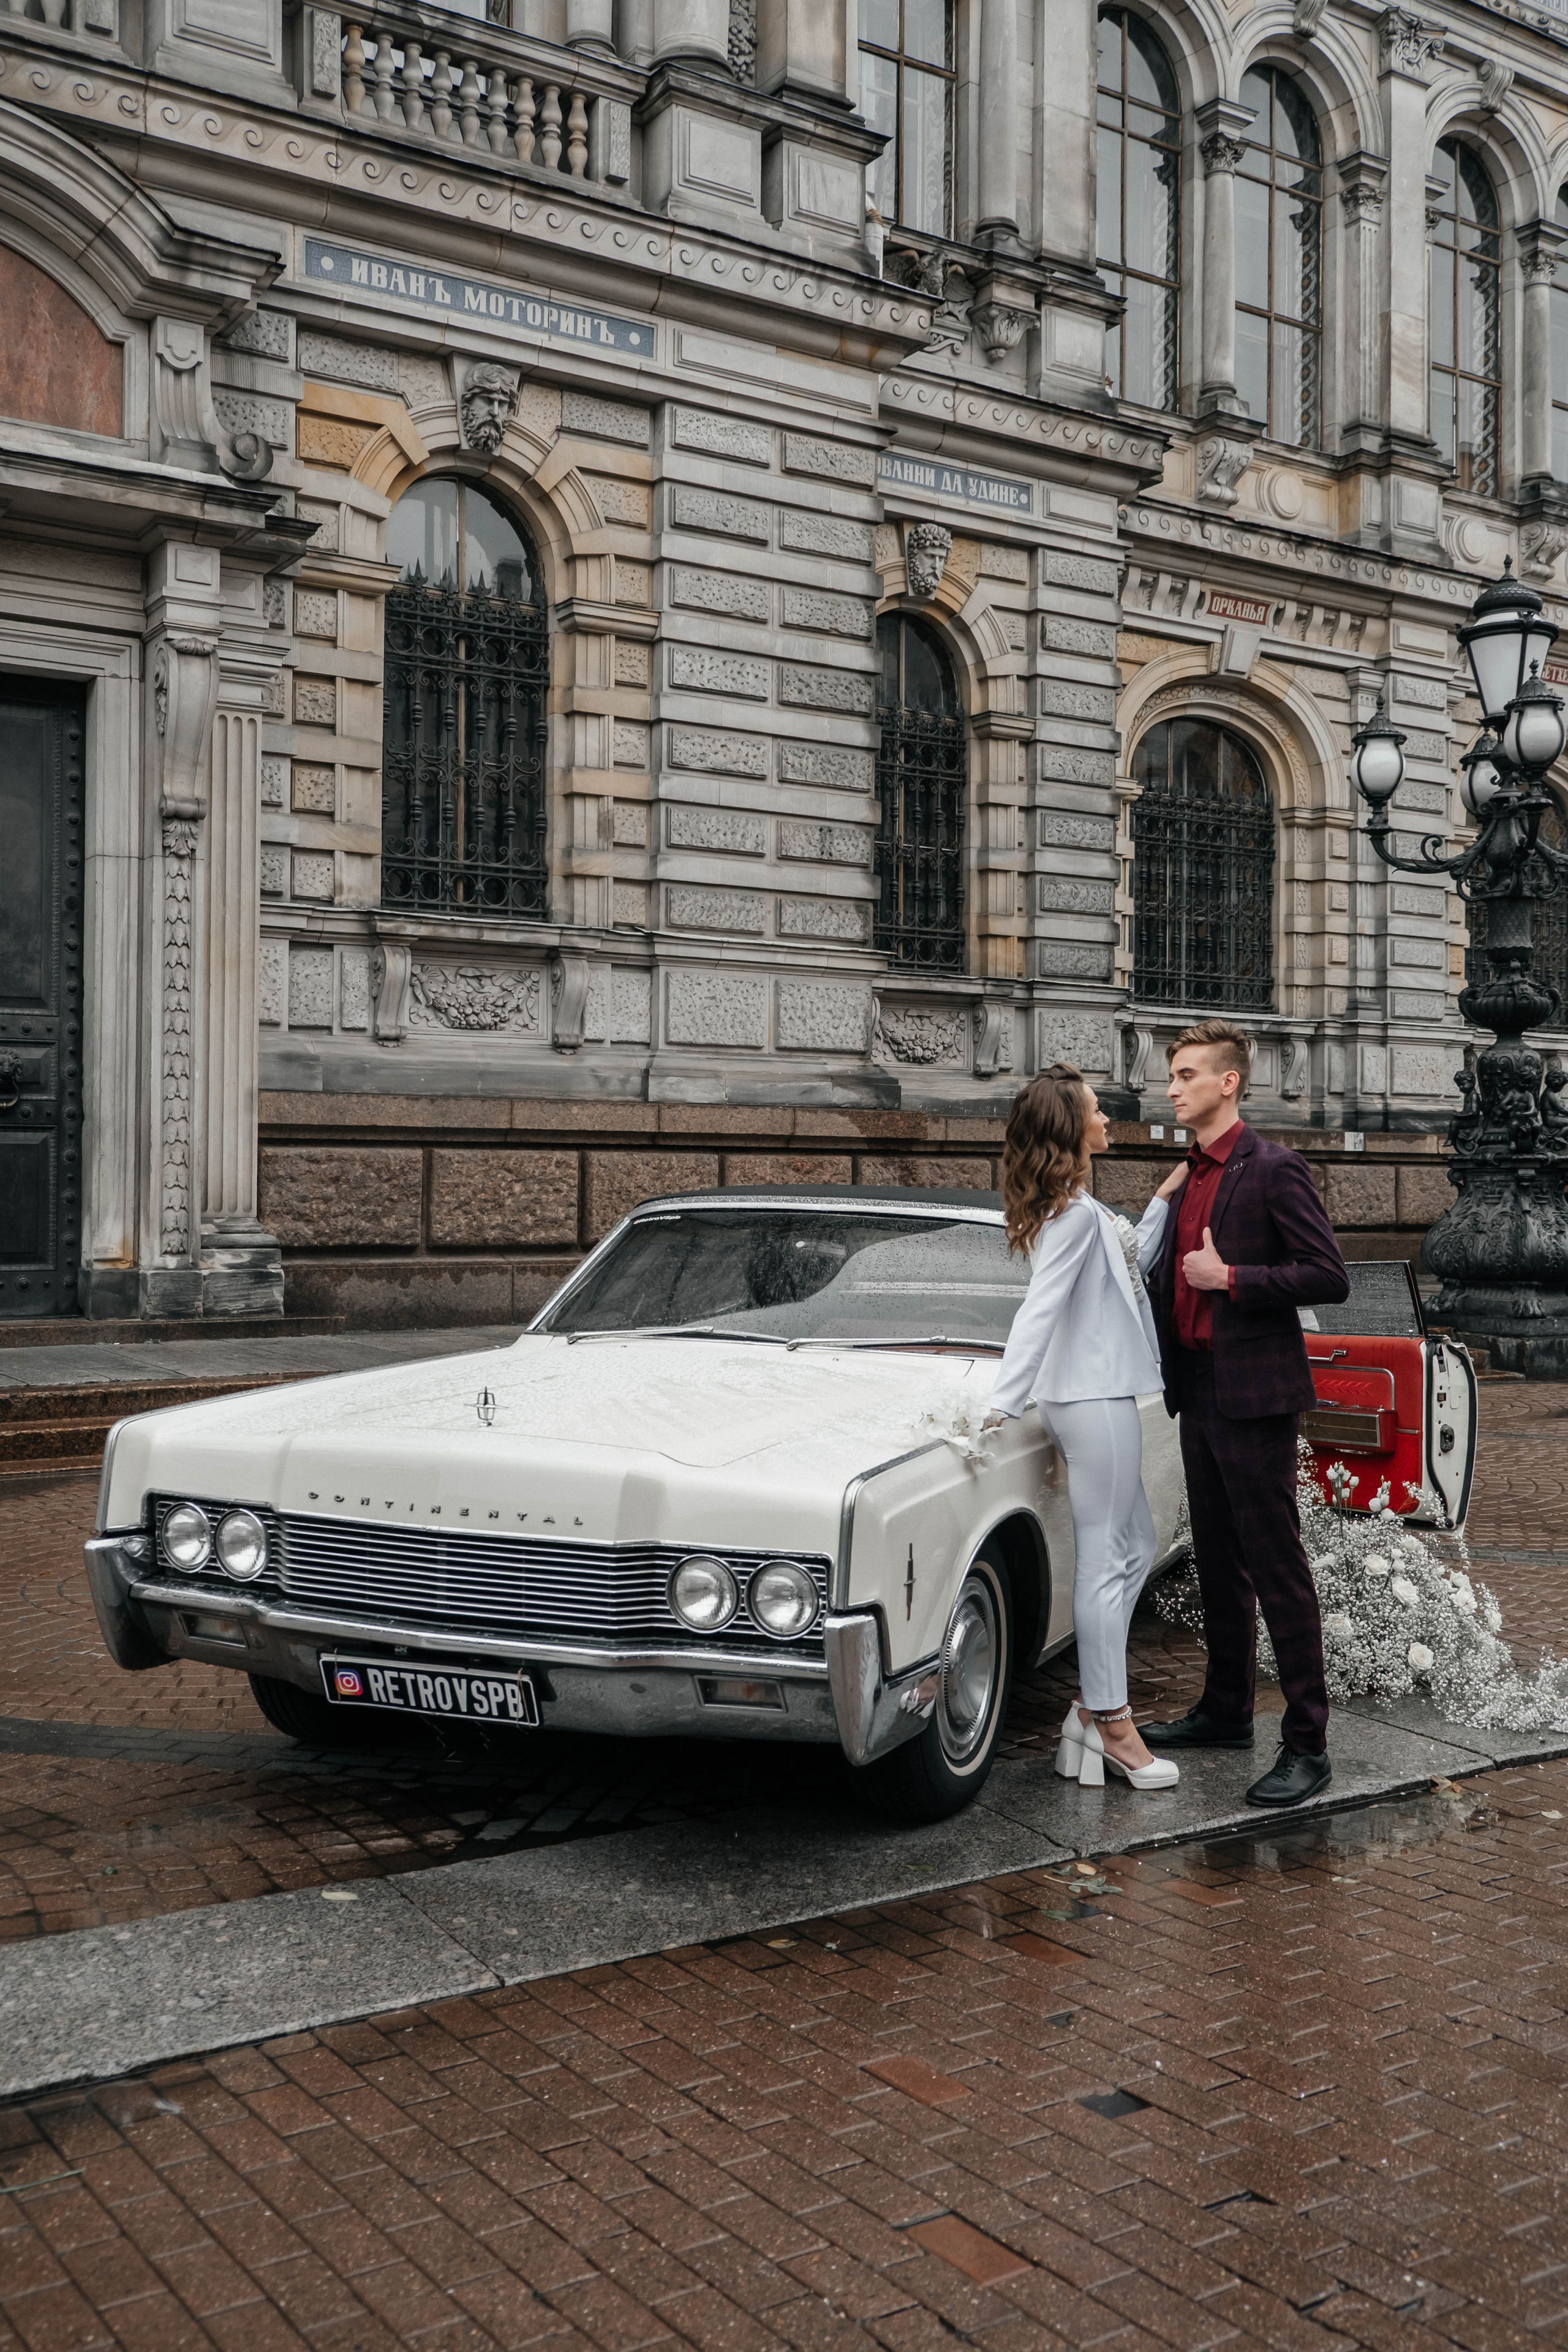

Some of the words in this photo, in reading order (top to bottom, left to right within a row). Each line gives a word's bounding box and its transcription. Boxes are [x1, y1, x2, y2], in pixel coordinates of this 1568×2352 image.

[351, 258, 451, 304] ИВАНЪ
[464, 285, 614, 344] МОТОРИНЪ
[941, 471, 962, 493] ДА
[968, 477, 1019, 506] УДИНЕ
[1212, 597, 1265, 621] ОРКАНЬЯ
[308, 1491, 583, 1526] CONTINENTAL
[366, 1668, 524, 1718] RETROVSPB
